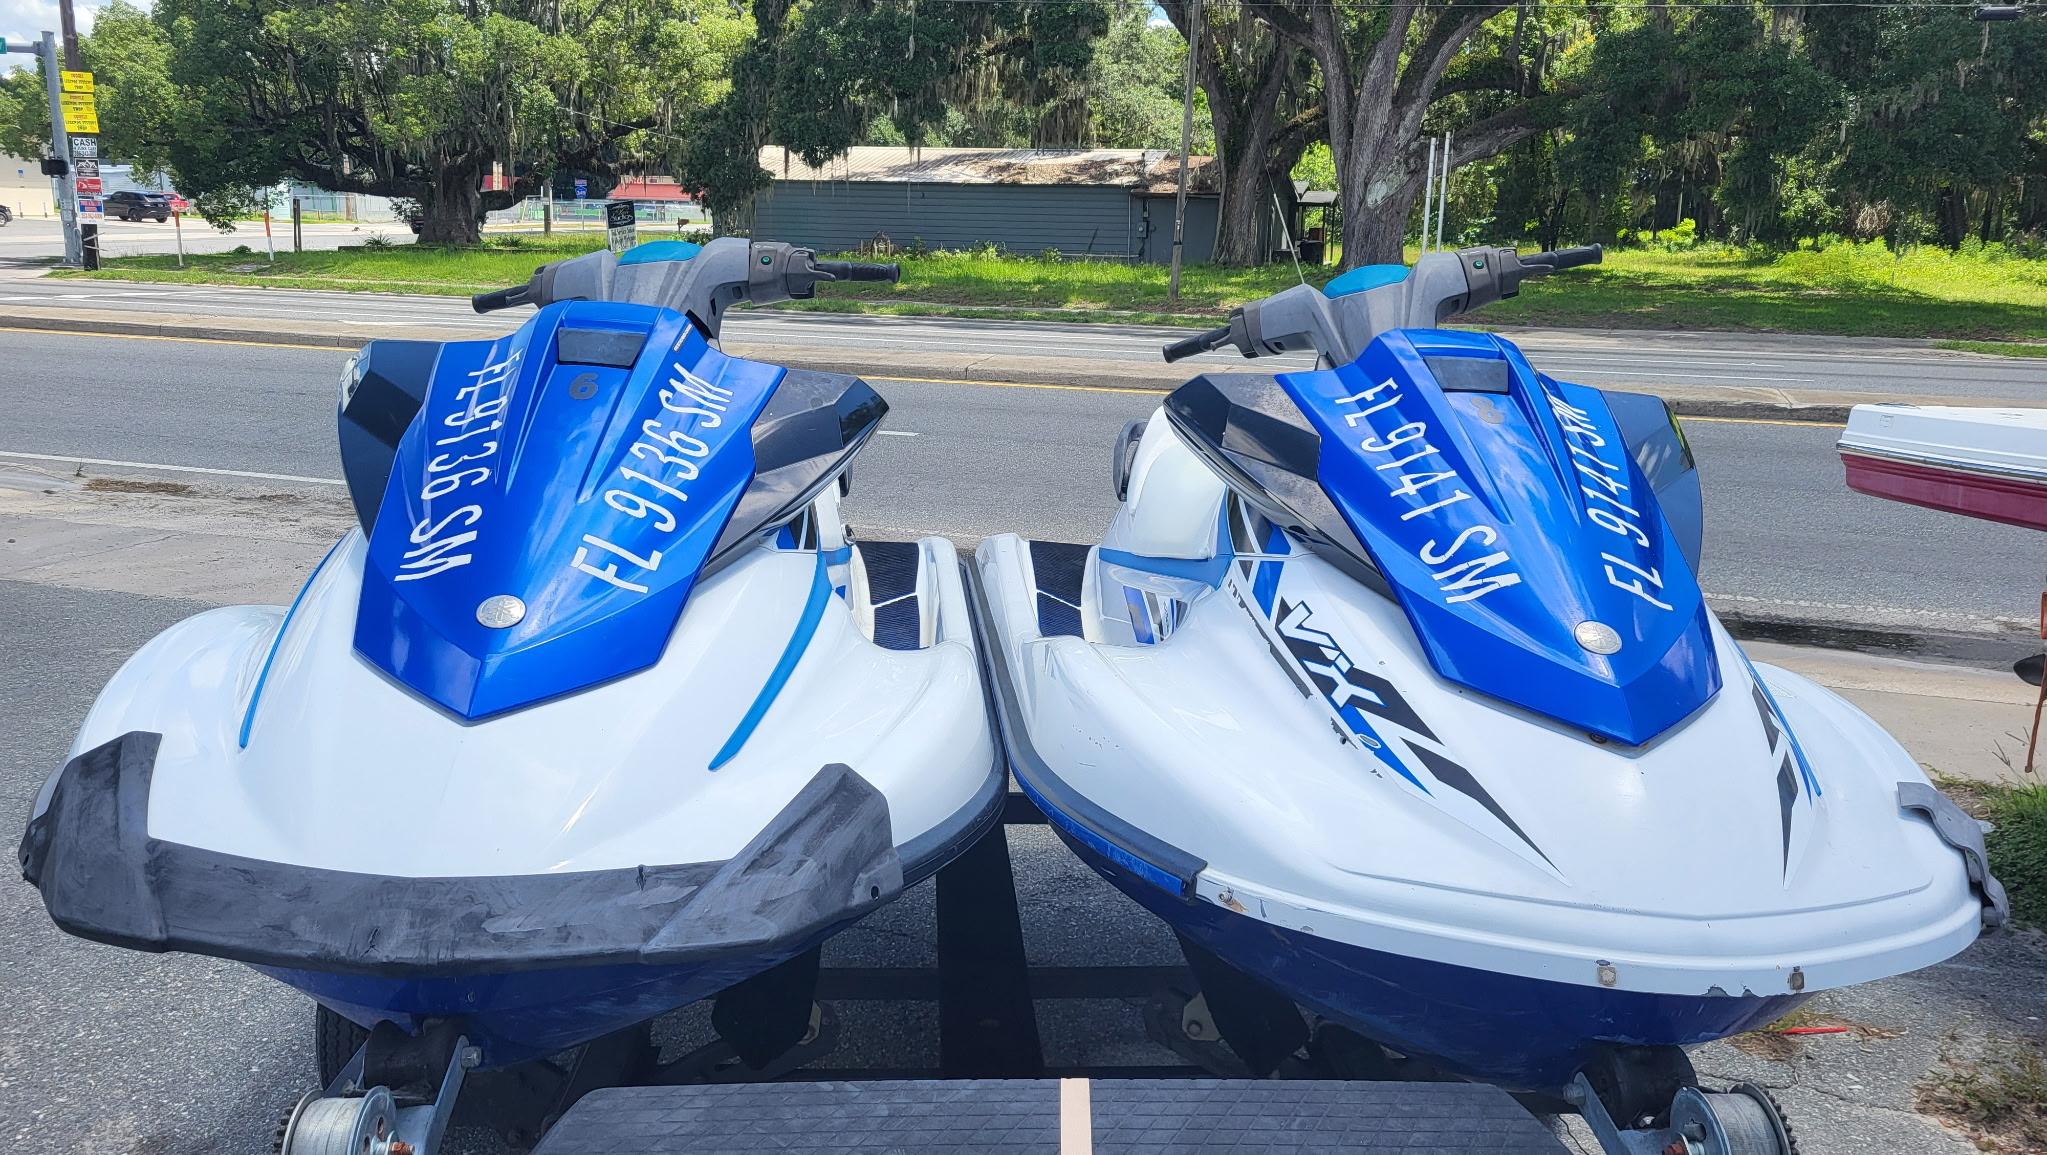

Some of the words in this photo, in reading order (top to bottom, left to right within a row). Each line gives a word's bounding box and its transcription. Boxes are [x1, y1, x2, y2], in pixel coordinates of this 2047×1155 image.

[73, 138, 97, 146] CASH
[456, 349, 523, 400] FL
[568, 372, 599, 400] 6
[659, 362, 734, 428] SM
[1334, 377, 1403, 427] FL
[421, 396, 508, 500] 9136
[1546, 394, 1606, 447] SM
[604, 419, 709, 532] 9136
[1361, 421, 1472, 521] 9141
[1566, 439, 1649, 547] 9141
[394, 504, 482, 582] SM
[570, 533, 663, 594] FL
[1419, 525, 1521, 604] SM
[1601, 551, 1673, 611] FL
[1276, 600, 1388, 710] VX
